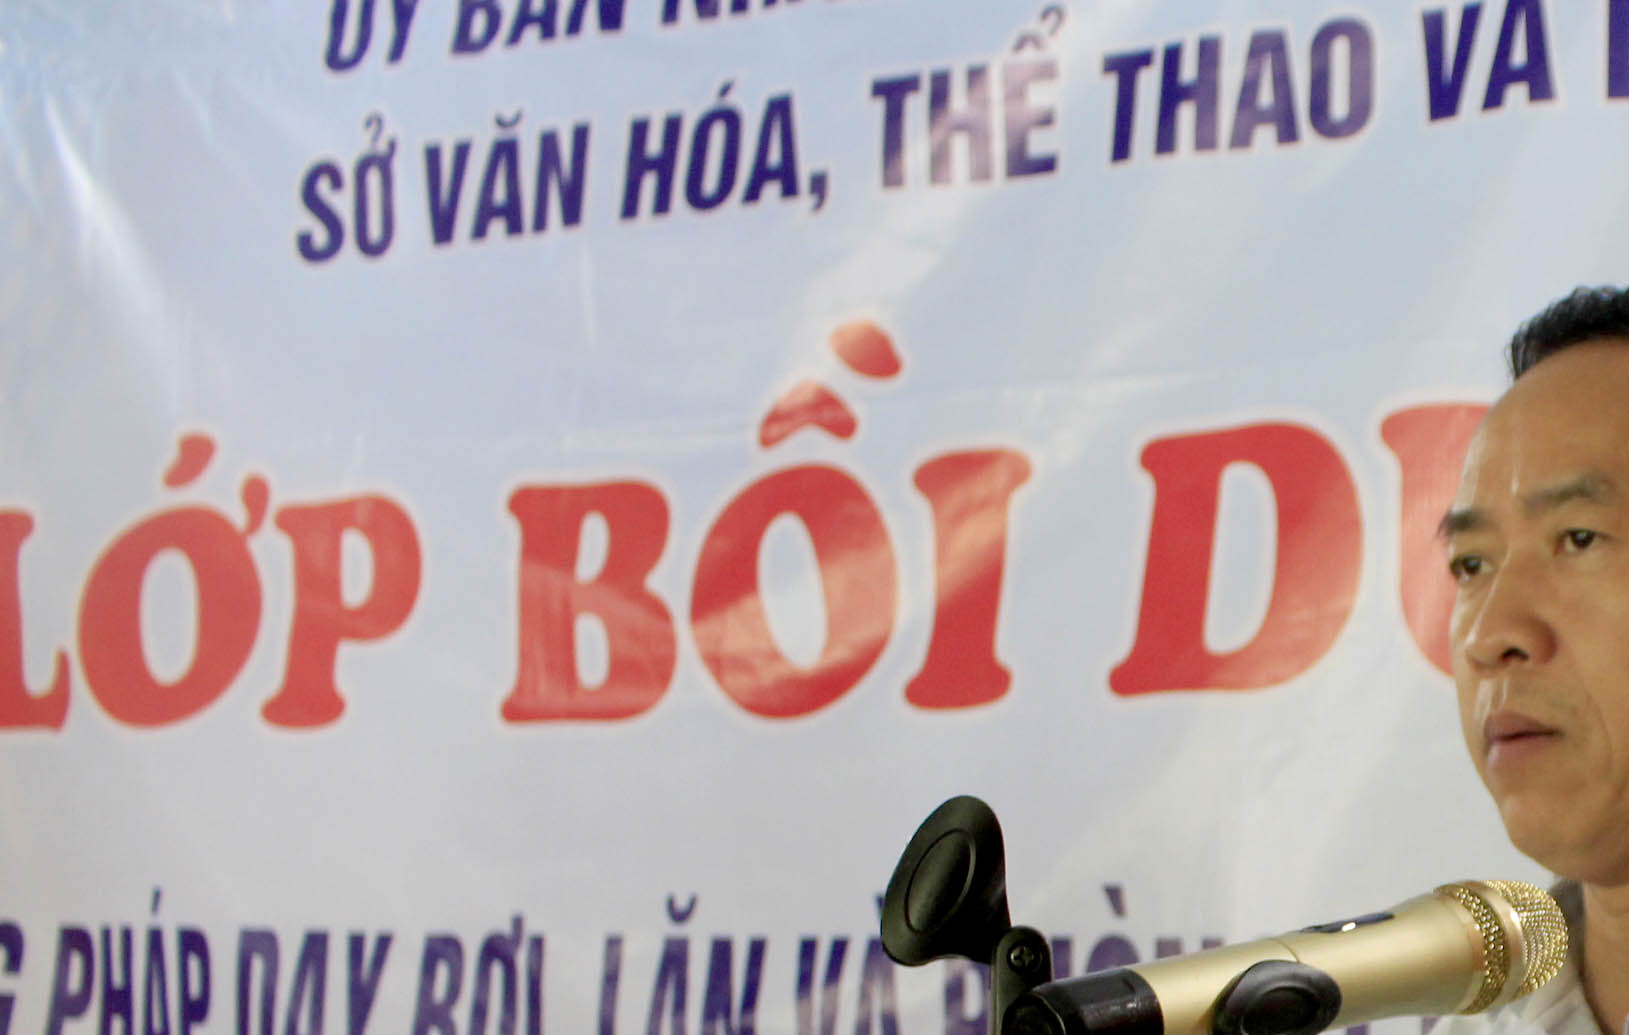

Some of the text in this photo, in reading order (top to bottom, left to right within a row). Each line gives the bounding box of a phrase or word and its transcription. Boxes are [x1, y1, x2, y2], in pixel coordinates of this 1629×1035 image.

[296, 113, 396, 264] SỞ
[424, 111, 591, 246] VĂN
[619, 80, 828, 219] HÓA,
[871, 6, 1067, 190] THỂ
[1103, 17, 1376, 164] THAO
[0, 430, 423, 731] LỚP
[501, 319, 1032, 724] BỒI
